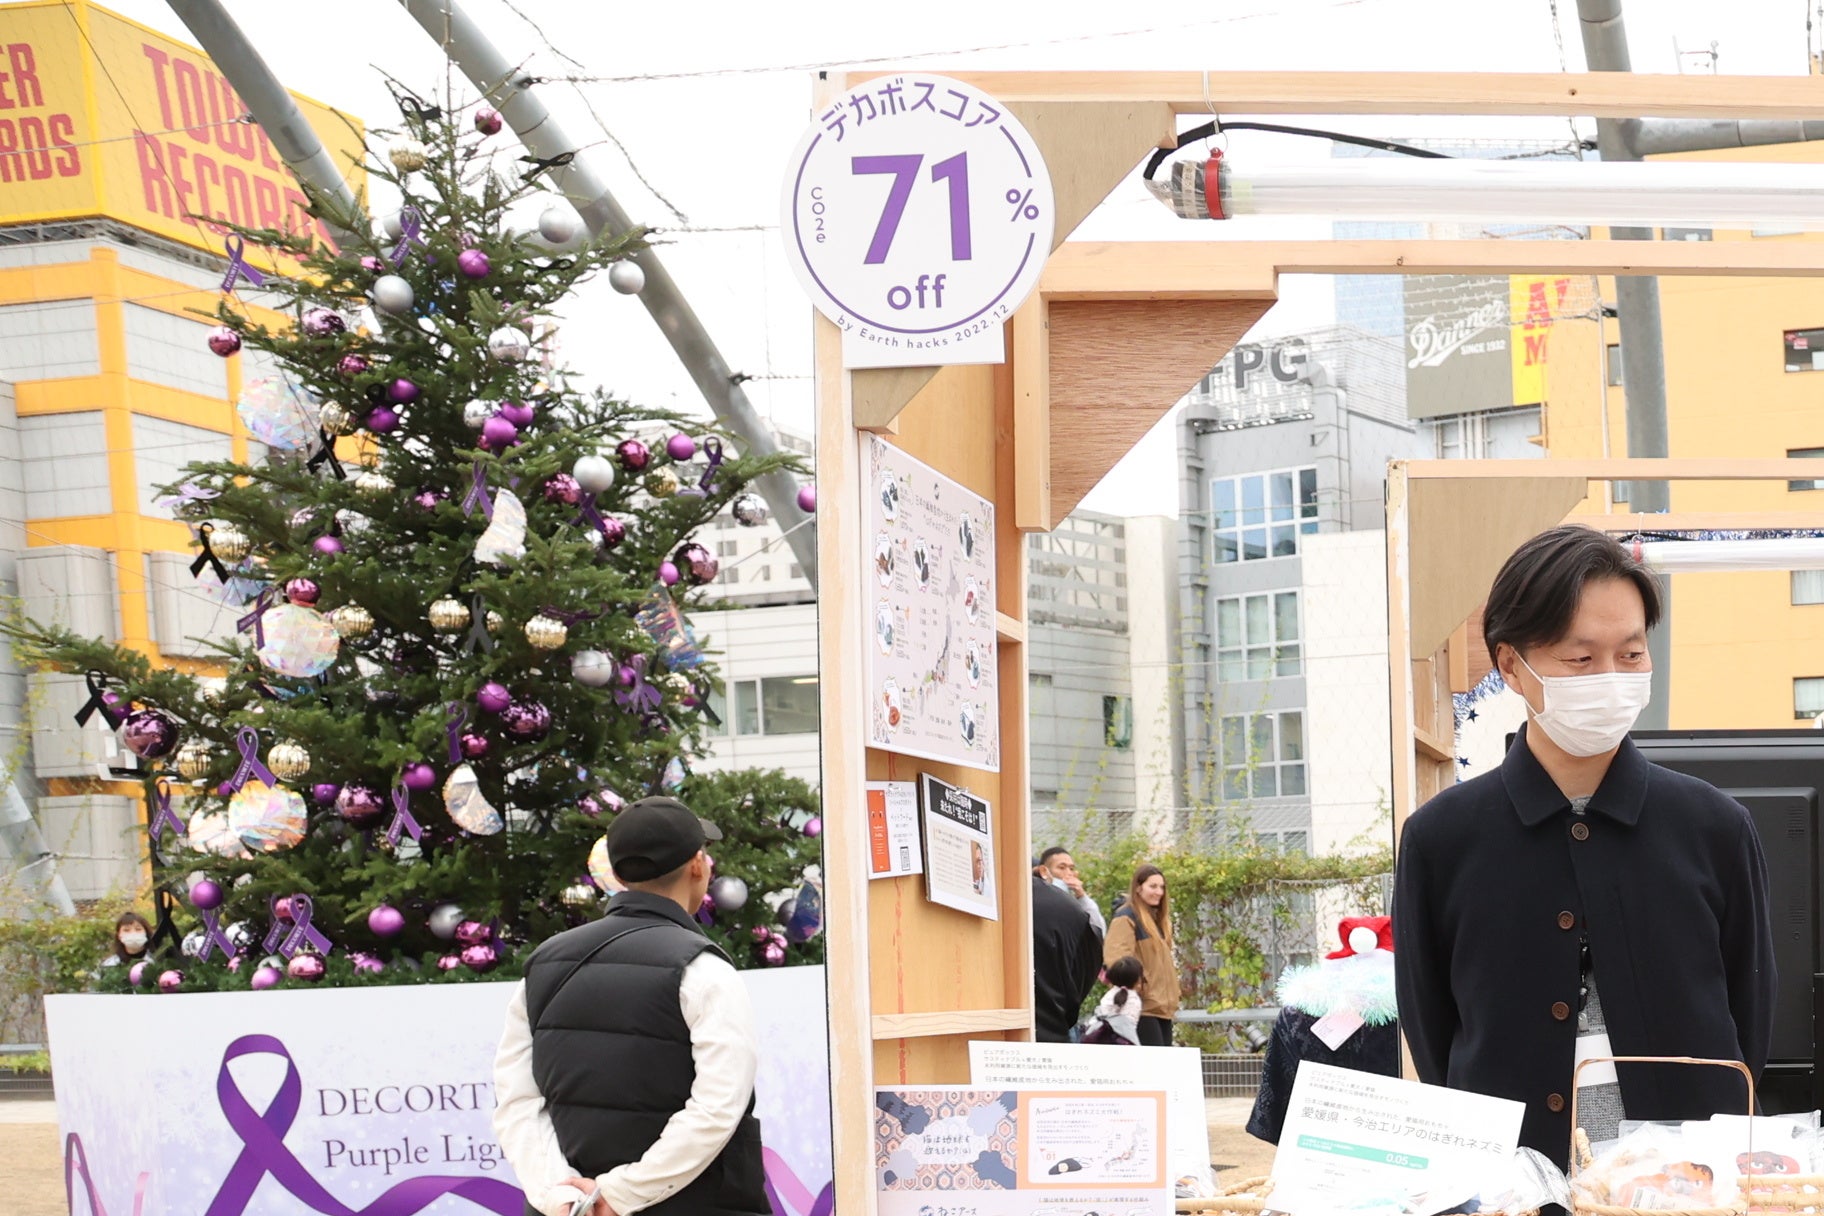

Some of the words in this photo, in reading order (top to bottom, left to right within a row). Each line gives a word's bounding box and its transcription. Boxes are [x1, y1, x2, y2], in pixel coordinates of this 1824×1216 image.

[821, 78, 1000, 142] デカボスコア
[811, 187, 826, 243] CO2e
[851, 151, 972, 264] 71
[1006, 188, 1039, 222] %
[887, 274, 946, 310] off
[837, 314, 853, 331] by
[859, 327, 899, 347] Earth
[907, 338, 949, 349] hacks
[955, 304, 1009, 342] 2022.12
[1408, 300, 1506, 369] Danner
[1460, 343, 1485, 355] SINCE
[1486, 340, 1506, 351] 1932
[1302, 1106, 1504, 1155] 愛媛県・今治エリアのはぎれネズミ
[322, 1136, 429, 1176] Purple
[1385, 1151, 1410, 1169] 0.05
[938, 1206, 977, 1216] ねこアース
